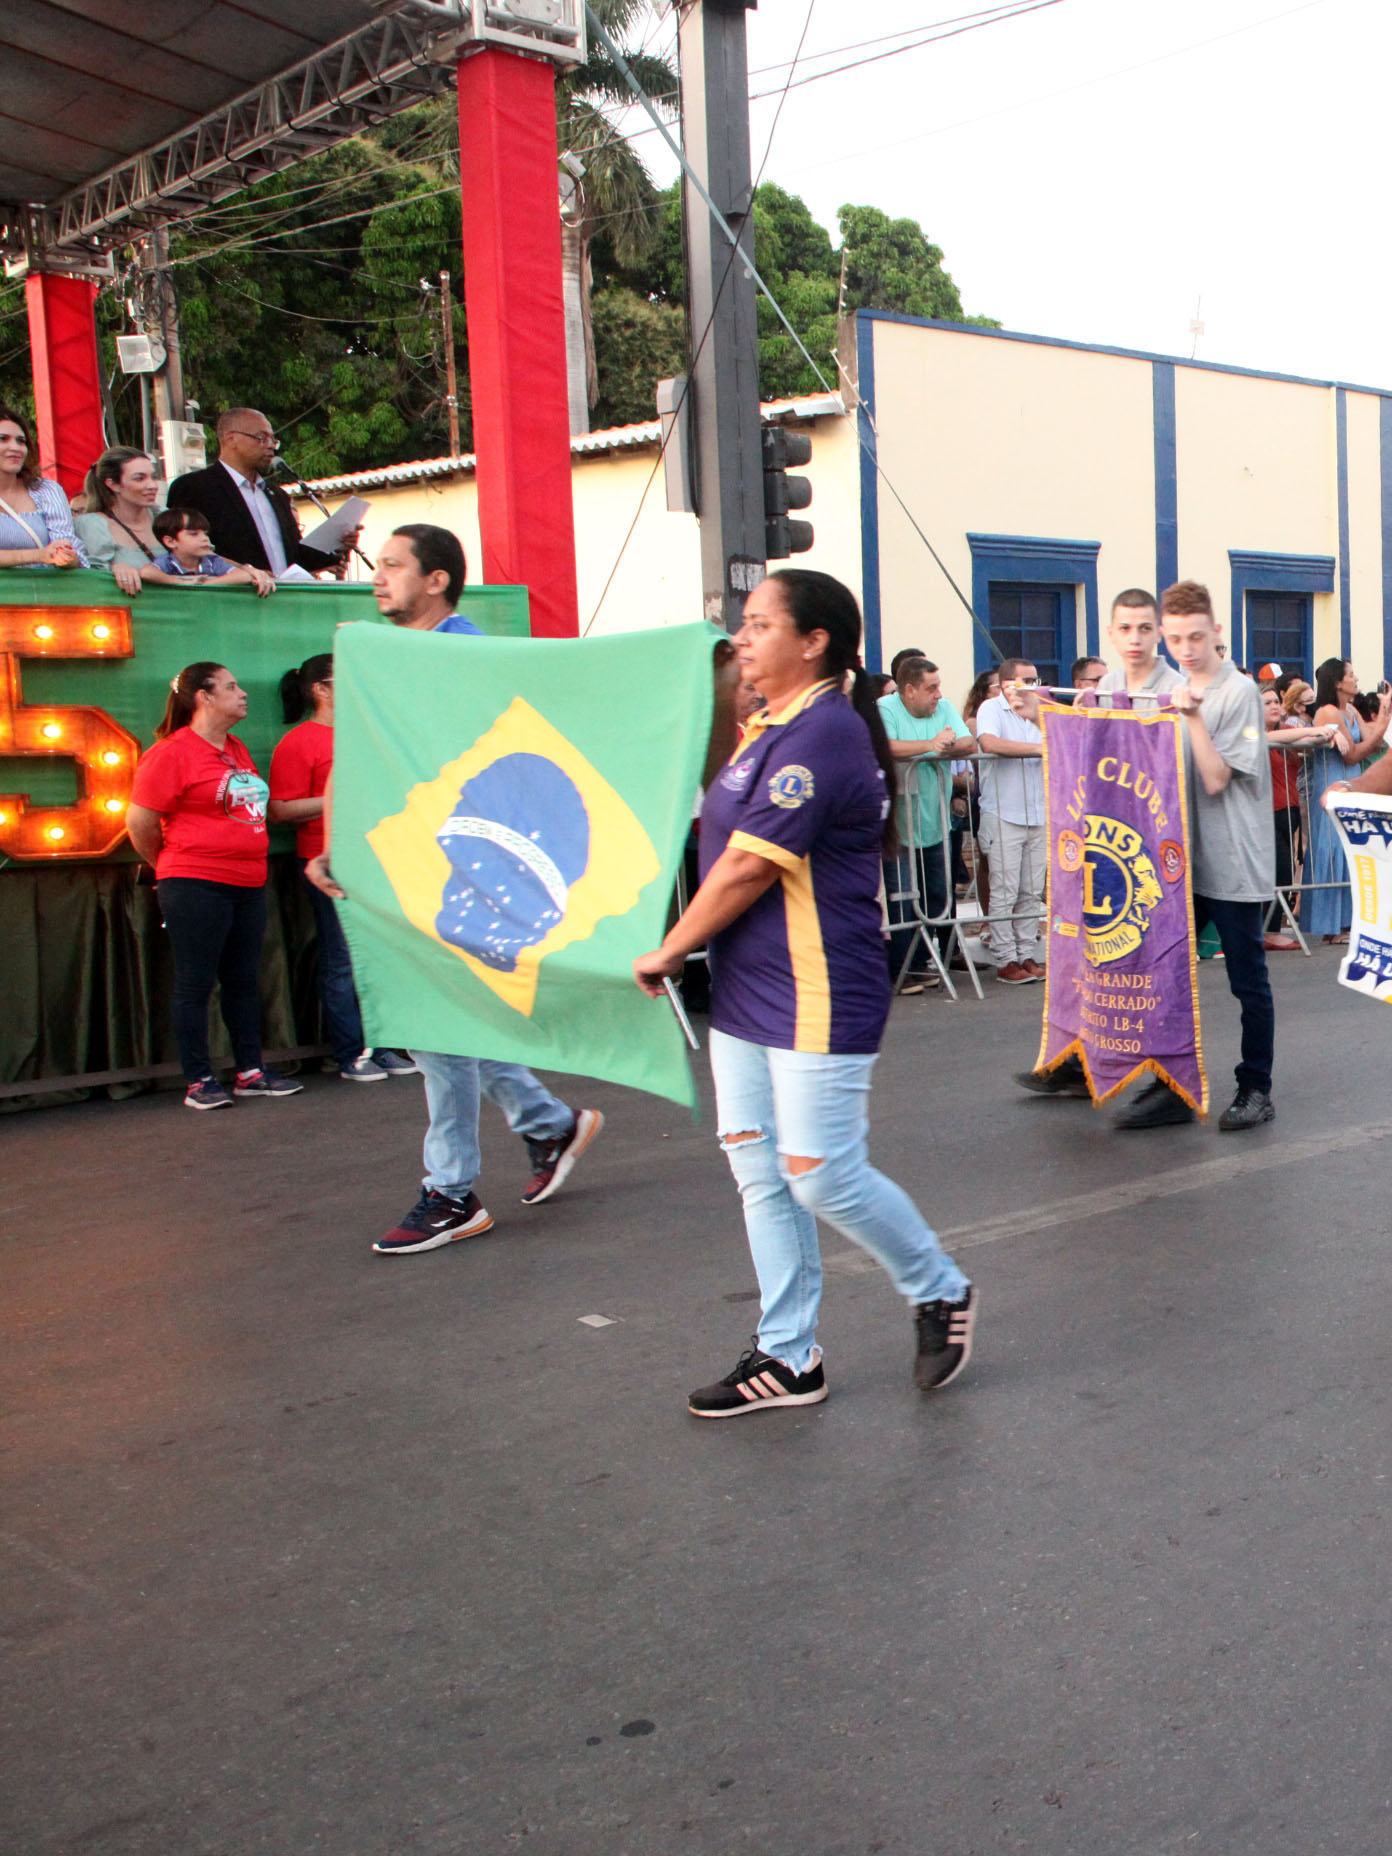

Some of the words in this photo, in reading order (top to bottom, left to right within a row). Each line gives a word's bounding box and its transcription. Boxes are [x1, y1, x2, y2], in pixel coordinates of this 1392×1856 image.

[1096, 756, 1169, 833] CLUBE
[1355, 954, 1381, 971] HÁ
[1095, 972, 1153, 989] GRANDE
[1113, 1016, 1145, 1033] LB-4
[1094, 1033, 1141, 1053] GROSSO
